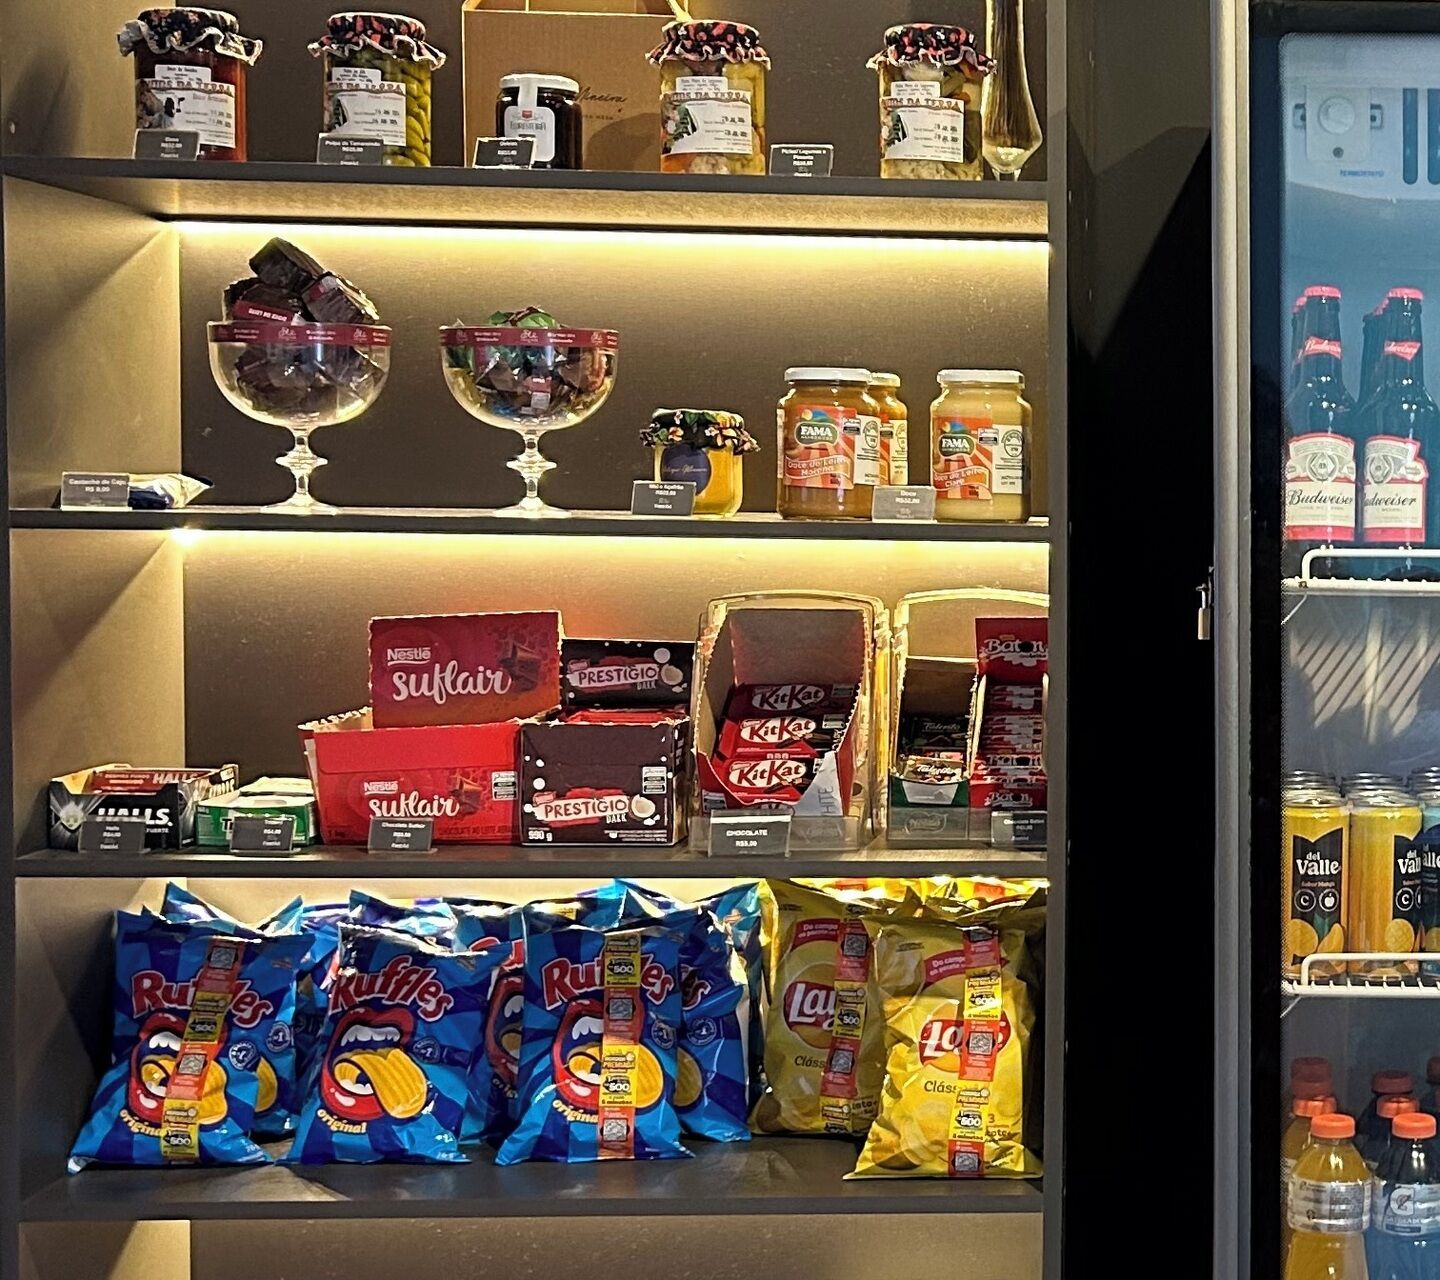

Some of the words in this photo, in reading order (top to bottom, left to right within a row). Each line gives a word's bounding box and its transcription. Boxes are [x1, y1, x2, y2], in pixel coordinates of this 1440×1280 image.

[800, 425, 833, 437] FAMA
[941, 438, 970, 448] FAMA
[387, 647, 432, 660] Nestlé
[392, 660, 512, 705] suflair
[760, 685, 823, 710] KitKat
[749, 717, 813, 742] KitKat
[152, 772, 199, 785] HALLS
[737, 761, 803, 787] KitKat
[363, 781, 399, 793] Nestlé
[368, 790, 461, 819] suflair
[817, 784, 835, 816] HITE
[605, 813, 628, 824] DARK
[726, 829, 768, 837] CHOCOLATE
[1305, 851, 1321, 861] del
[1295, 858, 1342, 876] Valle
[613, 964, 634, 973] 500
[329, 955, 454, 1022] Ruffles
[609, 1082, 630, 1092] 500
[552, 1099, 599, 1124] origina
[119, 1108, 164, 1137] origina
[316, 1108, 368, 1135] original
[169, 1136, 191, 1146] 500
